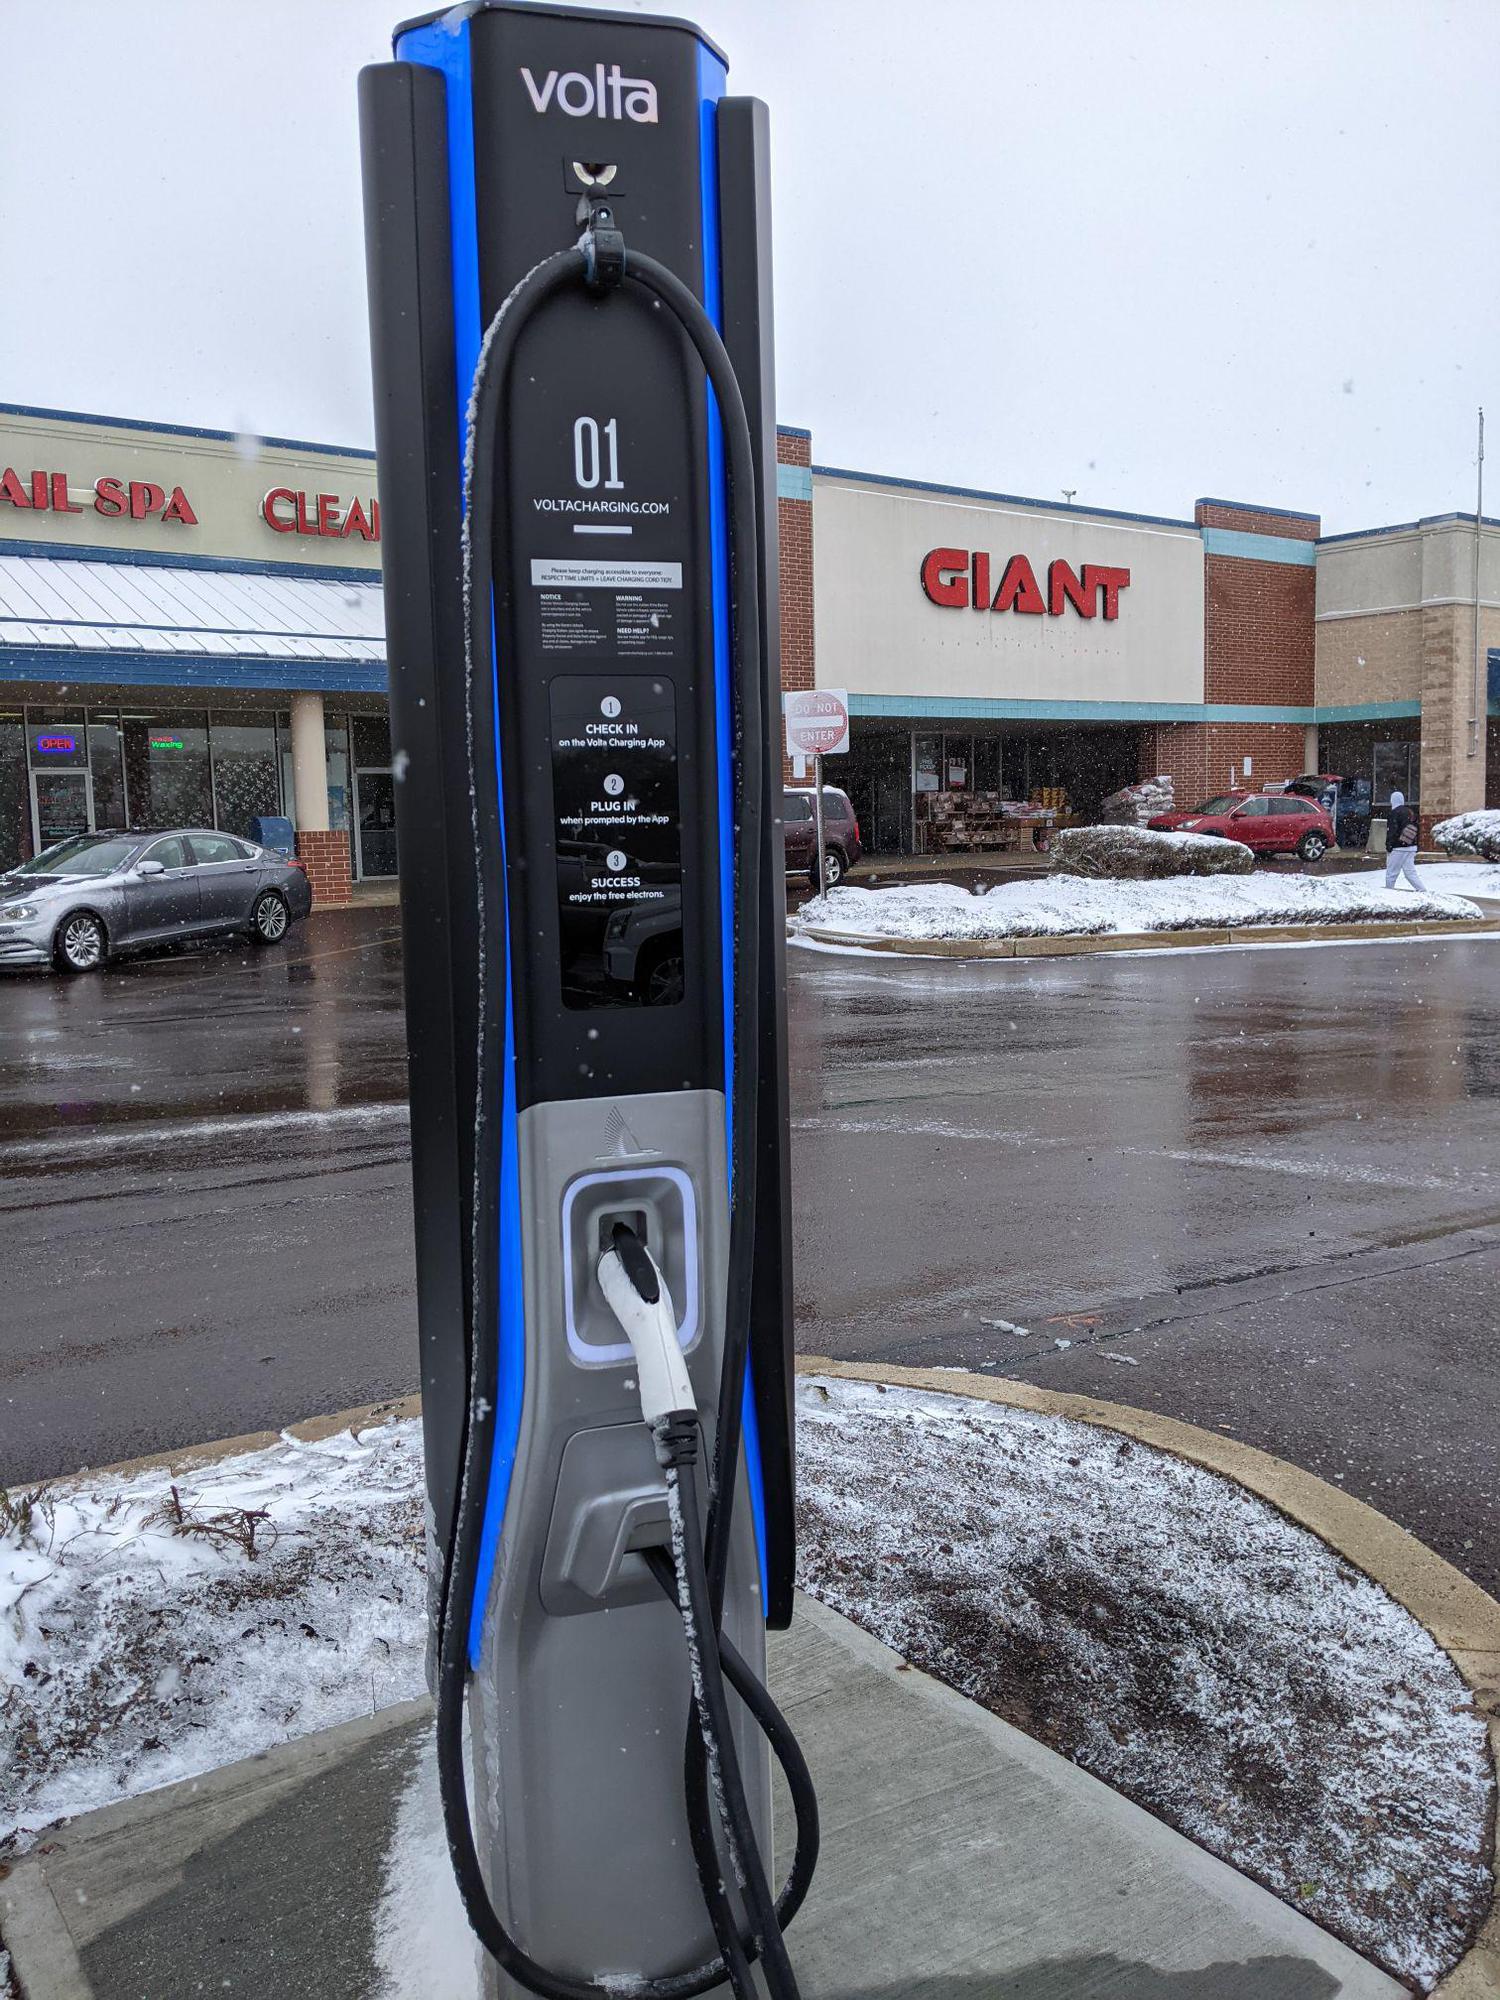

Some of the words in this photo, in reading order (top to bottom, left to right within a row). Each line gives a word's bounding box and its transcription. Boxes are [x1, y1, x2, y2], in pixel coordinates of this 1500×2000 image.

[520, 63, 659, 124] volta
[574, 416, 625, 489] 01
[94, 476, 199, 525] SPA
[533, 499, 670, 515] VOLTACHARGING.COM
[582, 568, 605, 576] charging
[920, 547, 1131, 620] GIANT
[796, 704, 810, 715] DO
[817, 702, 838, 713] NOT
[585, 723, 624, 734] CHECK
[626, 724, 638, 734] IN
[800, 730, 835, 741] ENTER
[41, 738, 73, 749] OPEN
[151, 741, 184, 750] Waxing
[571, 738, 586, 746] the
[586, 738, 608, 746] Volta
[608, 738, 646, 748] Charging
[647, 738, 666, 748] App
[590, 801, 621, 812] PLUG
[623, 801, 636, 811] IN
[560, 816, 583, 824] when
[584, 815, 625, 826] prompted
[626, 815, 637, 824] by
[638, 814, 651, 823] the
[651, 814, 670, 824] App
[591, 877, 641, 888] SUCCESS
[569, 892, 592, 902] enjoy
[593, 891, 607, 900] the
[608, 891, 625, 900] free
[626, 890, 665, 899] electrons.
